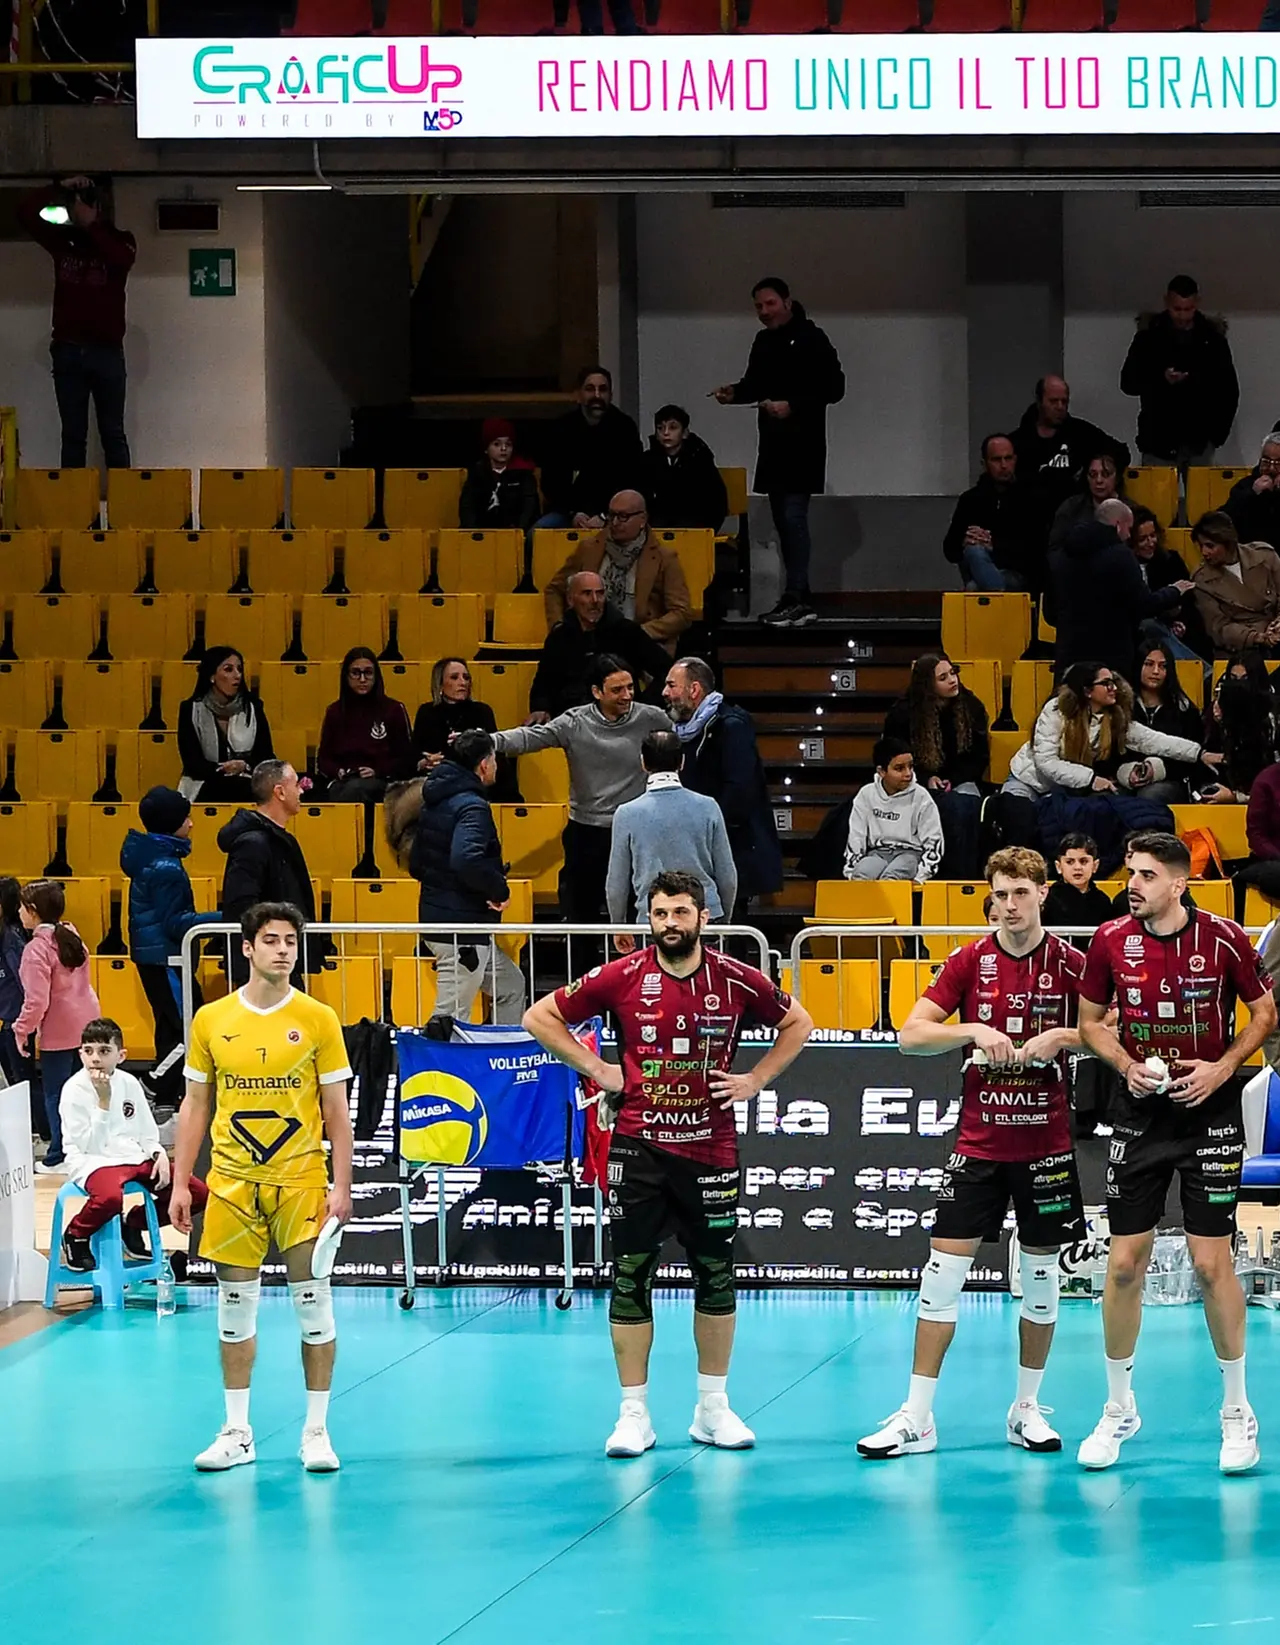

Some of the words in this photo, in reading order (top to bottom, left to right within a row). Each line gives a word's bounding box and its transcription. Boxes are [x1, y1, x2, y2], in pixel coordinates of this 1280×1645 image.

[538, 59, 767, 112] RENDIAMO
[795, 57, 931, 110] UNICO
[959, 57, 992, 109] IL
[1015, 57, 1099, 109] TUO
[1127, 56, 1277, 109] BRAND
[194, 114, 333, 127] POWERED
[366, 114, 395, 127] BY
[1160, 978, 1171, 993] 6
[1006, 993, 1027, 1009] 35
[676, 1014, 686, 1030] 8
[1153, 1022, 1210, 1034] DOMOTEK
[255, 1048, 267, 1064] 7
[516, 1070, 538, 1081] FIVB
[979, 1091, 1049, 1106] CANALE
[642, 1107, 710, 1125] CANALE
[995, 1113, 1010, 1122] CTL
[1012, 1113, 1048, 1122] ECOLOGY
[745, 1166, 835, 1195] per
